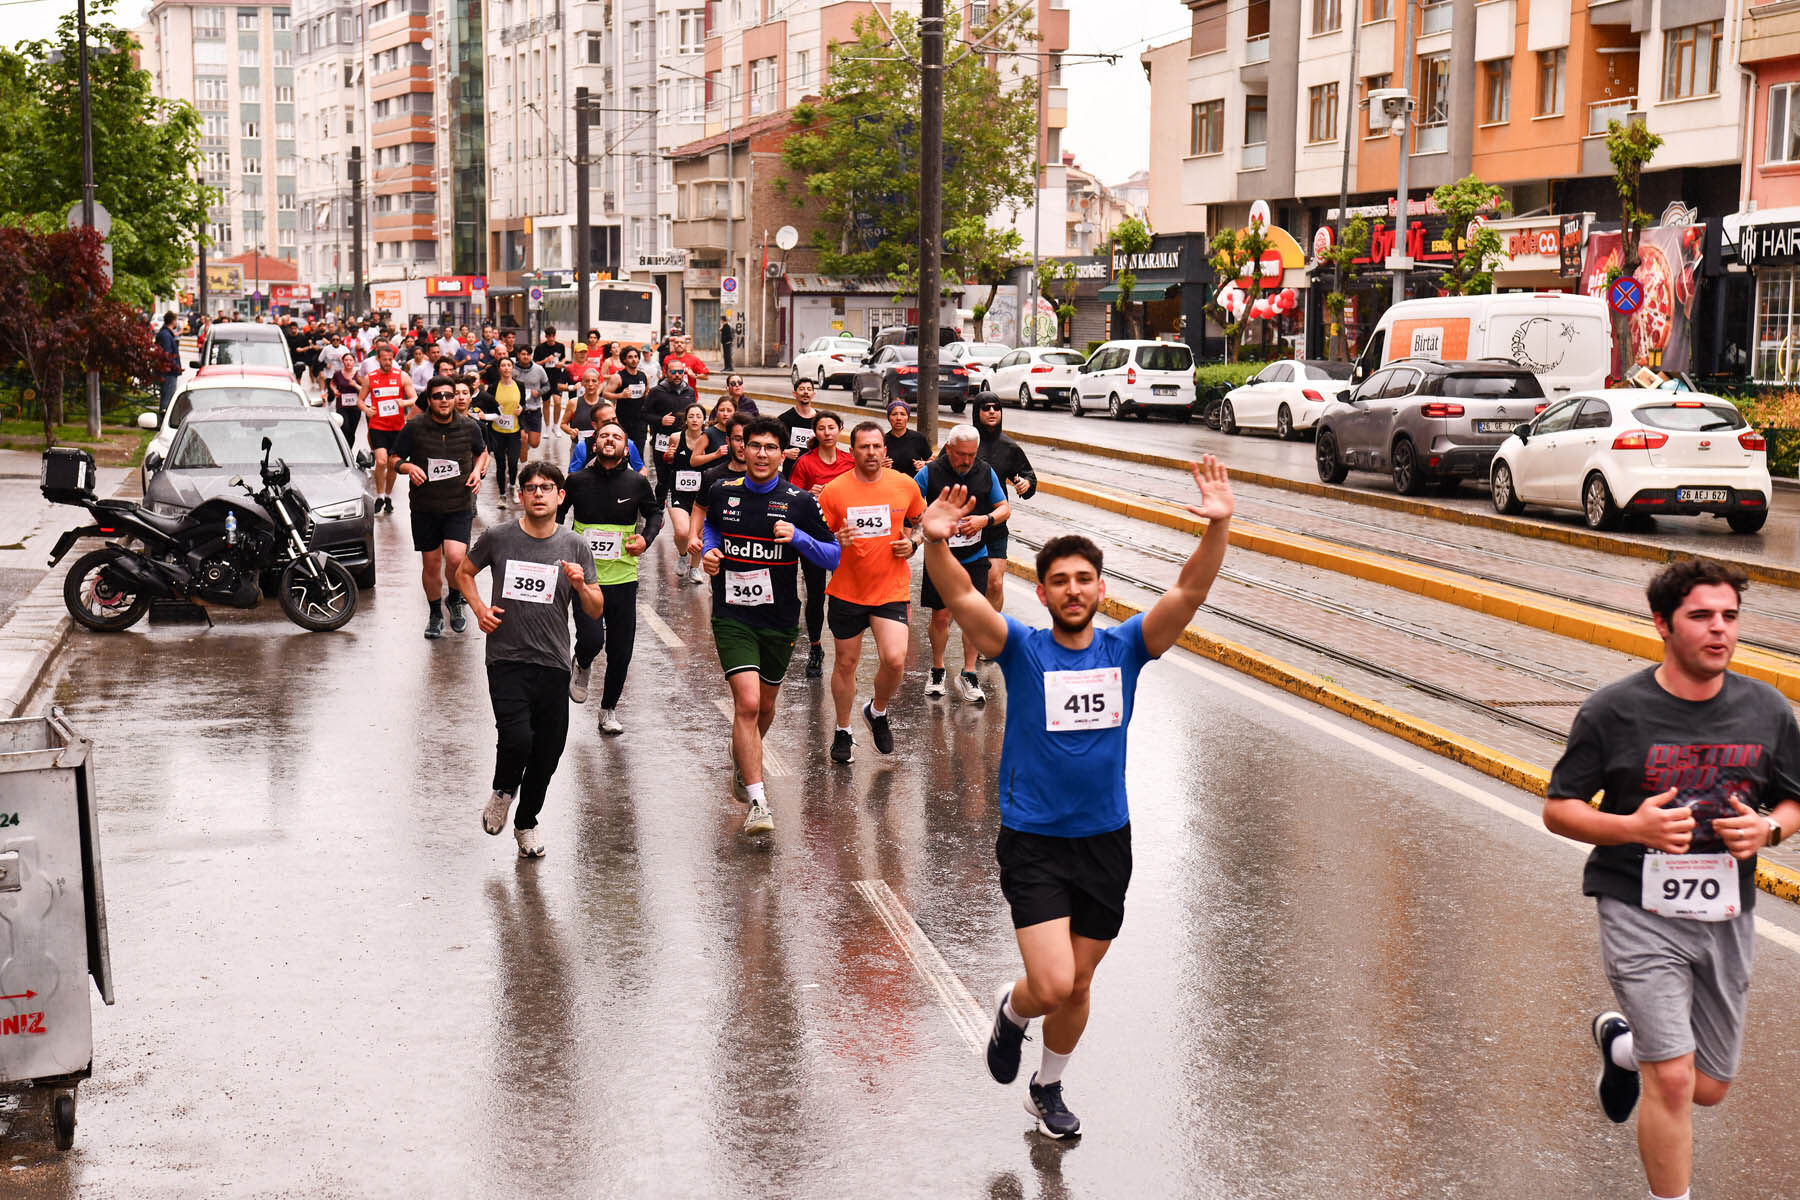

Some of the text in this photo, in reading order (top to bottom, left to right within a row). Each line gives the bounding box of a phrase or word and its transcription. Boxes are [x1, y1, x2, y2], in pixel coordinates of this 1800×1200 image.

[1138, 251, 1179, 269] KARAMAN
[433, 464, 453, 474] 423
[680, 478, 697, 487] 059
[1682, 490, 1726, 500] 26 AEJ 627
[856, 516, 883, 528] 843
[590, 541, 615, 552] 357
[723, 538, 783, 560] Red Bull
[513, 576, 546, 592] 389
[733, 584, 763, 598] 340
[1064, 693, 1106, 714] 415
[1663, 878, 1720, 900] 970
